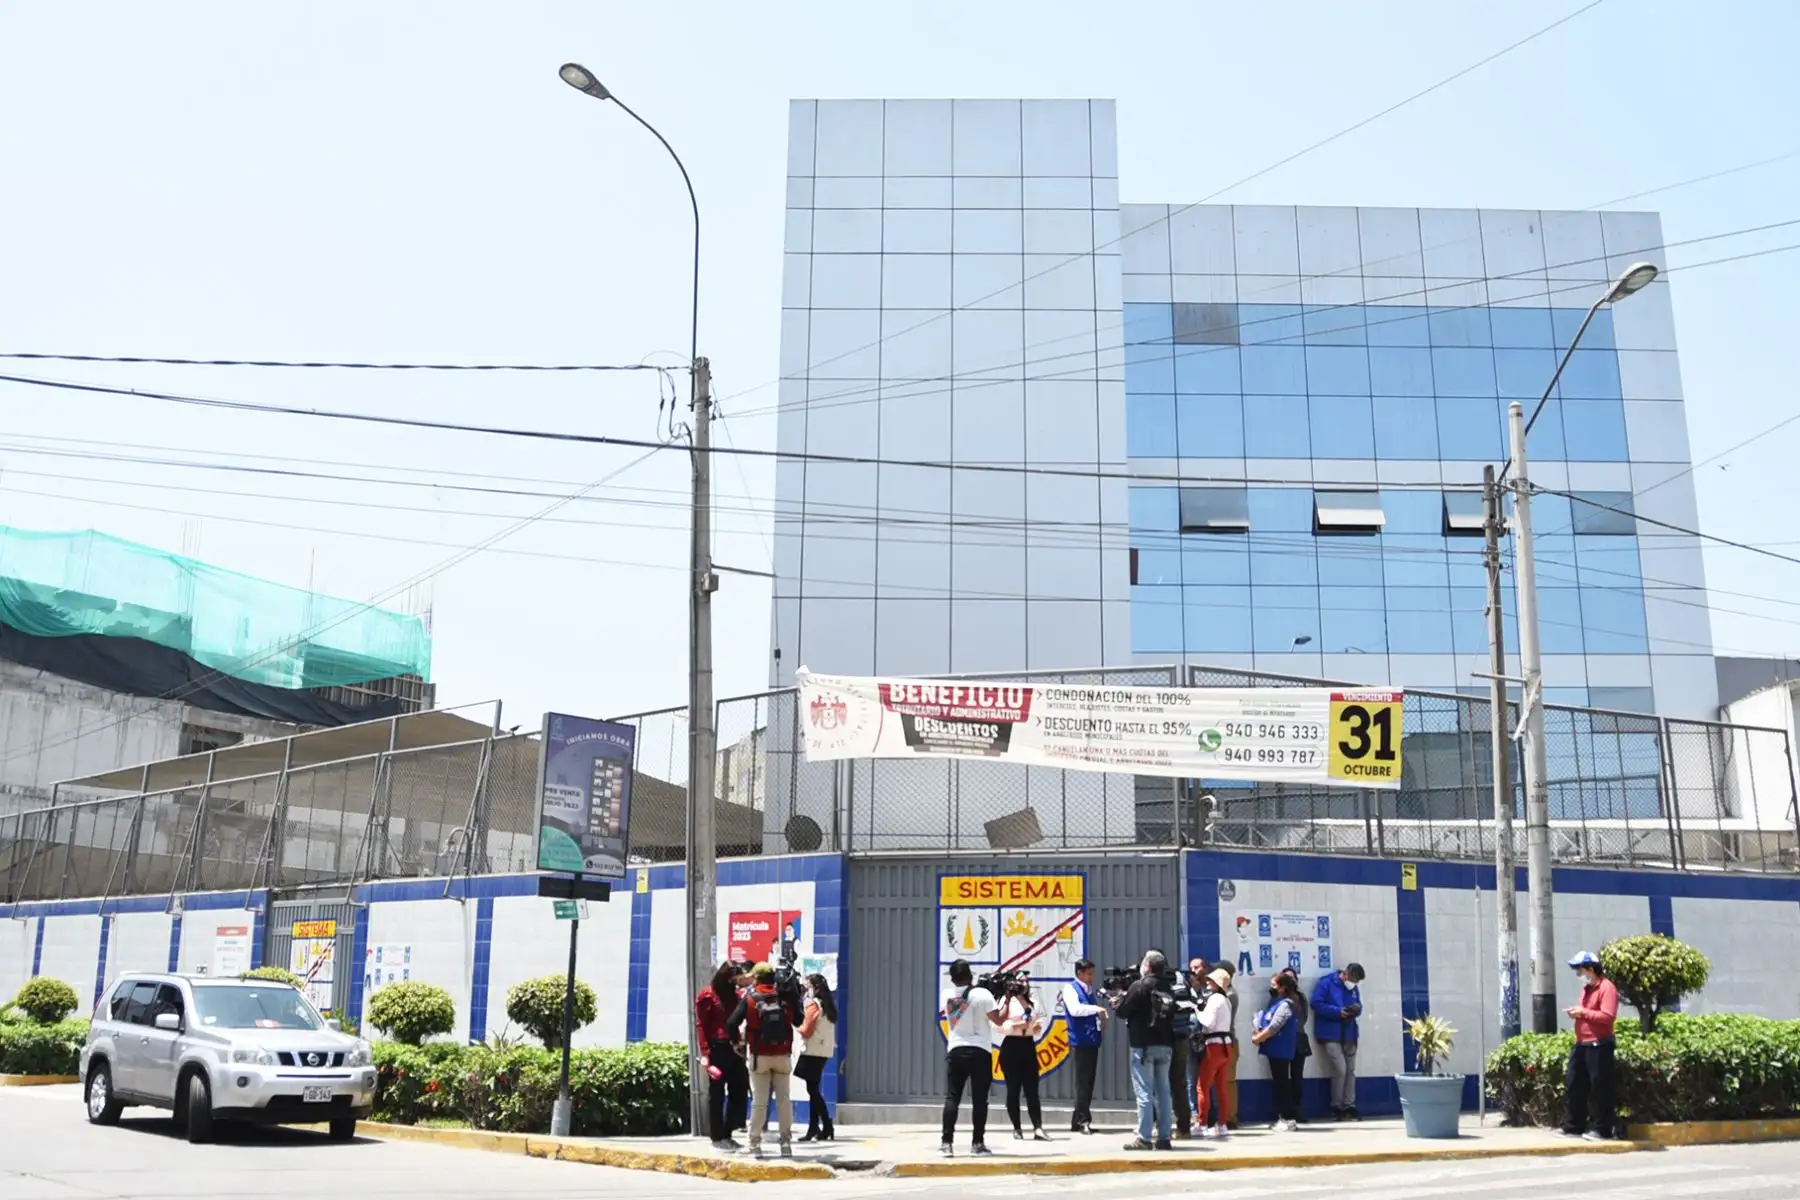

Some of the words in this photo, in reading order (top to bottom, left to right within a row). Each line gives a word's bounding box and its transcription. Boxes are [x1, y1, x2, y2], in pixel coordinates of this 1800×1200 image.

[890, 685, 1024, 709] BENEFICIO
[1136, 694, 1152, 705] DEL
[1156, 692, 1192, 706] 100%
[914, 716, 999, 739] DESCUENTOS
[1044, 716, 1112, 733] DESCUENTO
[1115, 722, 1146, 735] HASTA
[1149, 723, 1159, 735] EL
[1162, 721, 1192, 736] 95%
[1225, 723, 1252, 738] 940
[1259, 724, 1285, 739] 946
[1292, 725, 1318, 740] 333
[1338, 704, 1396, 761] 31
[1224, 748, 1252, 762] 940
[1258, 749, 1284, 763] 993
[1291, 750, 1315, 764] 787
[1344, 764, 1392, 777] OCTUBRE
[959, 880, 1065, 899] SISTEMA
[298, 923, 329, 937] SISTEMA
